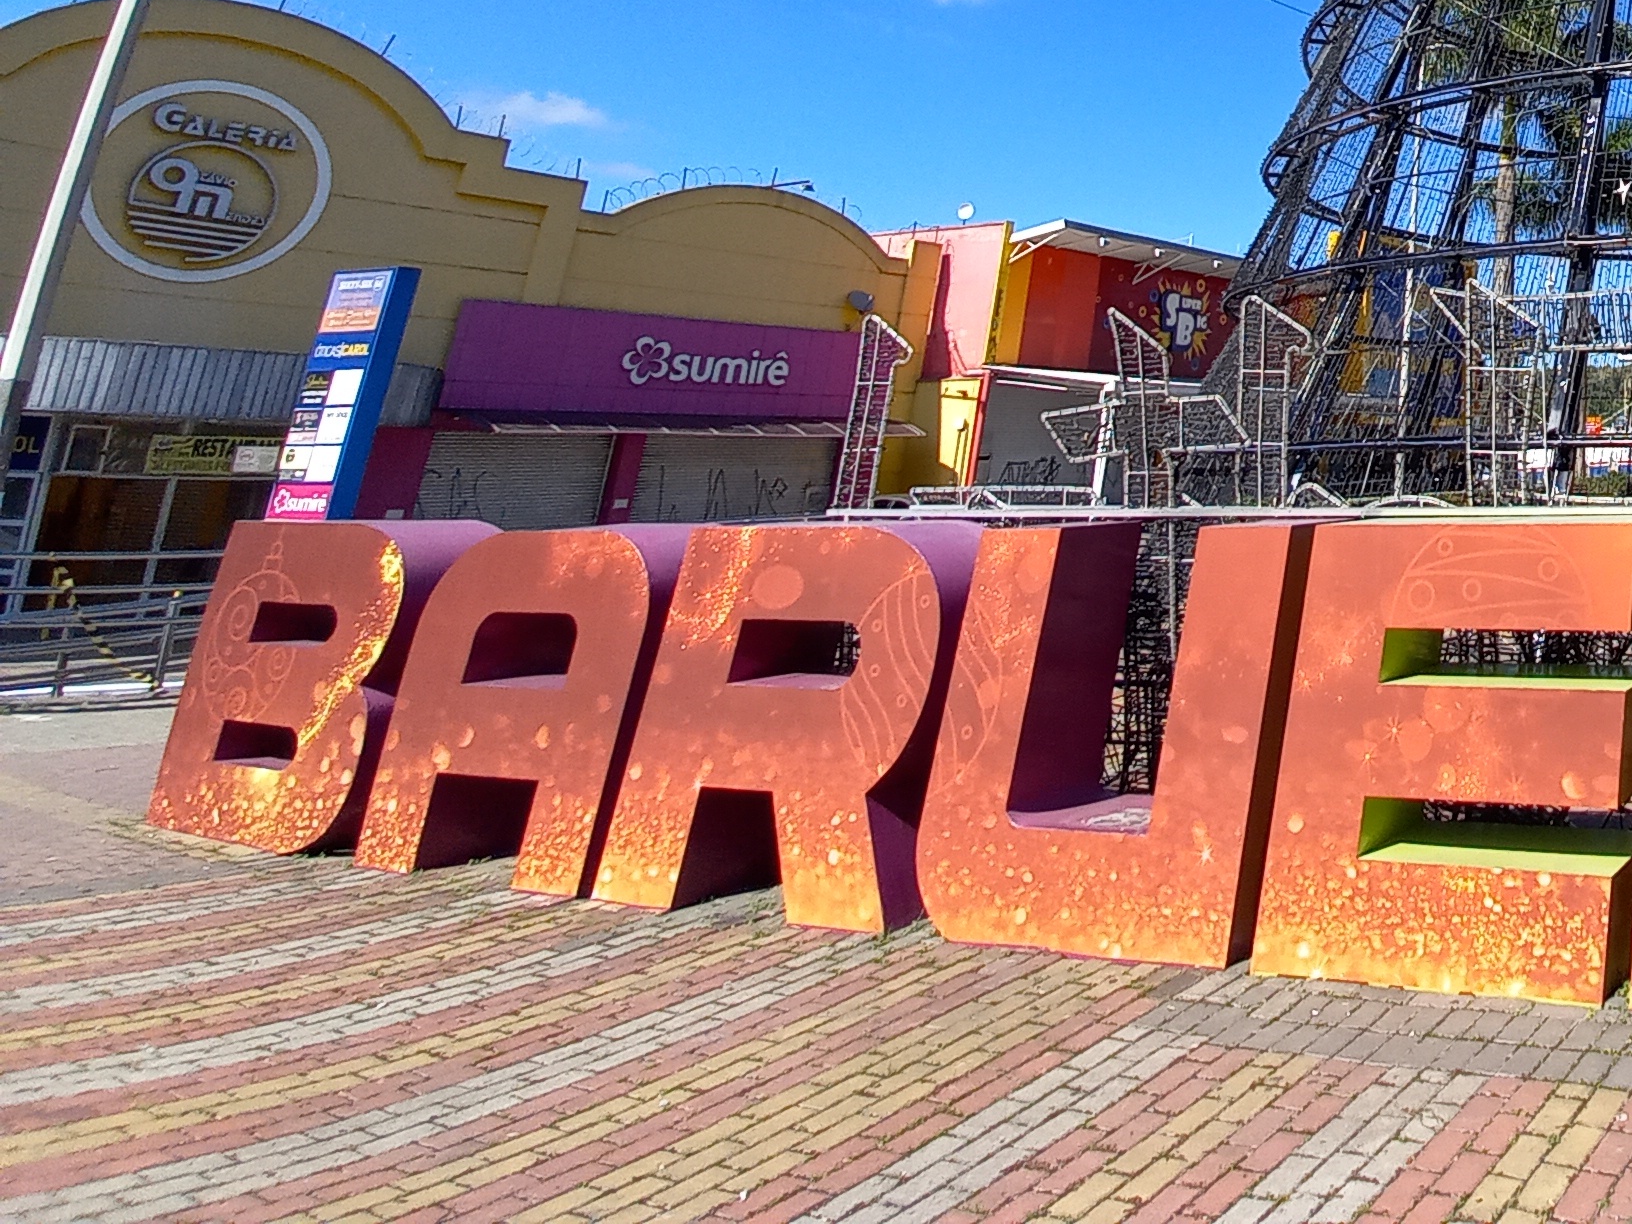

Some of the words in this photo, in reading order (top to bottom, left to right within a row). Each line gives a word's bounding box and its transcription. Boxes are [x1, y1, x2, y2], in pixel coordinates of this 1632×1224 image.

[1166, 293, 1202, 327] SUPER
[1175, 312, 1208, 346] BIG
[669, 349, 790, 386] sumirê
